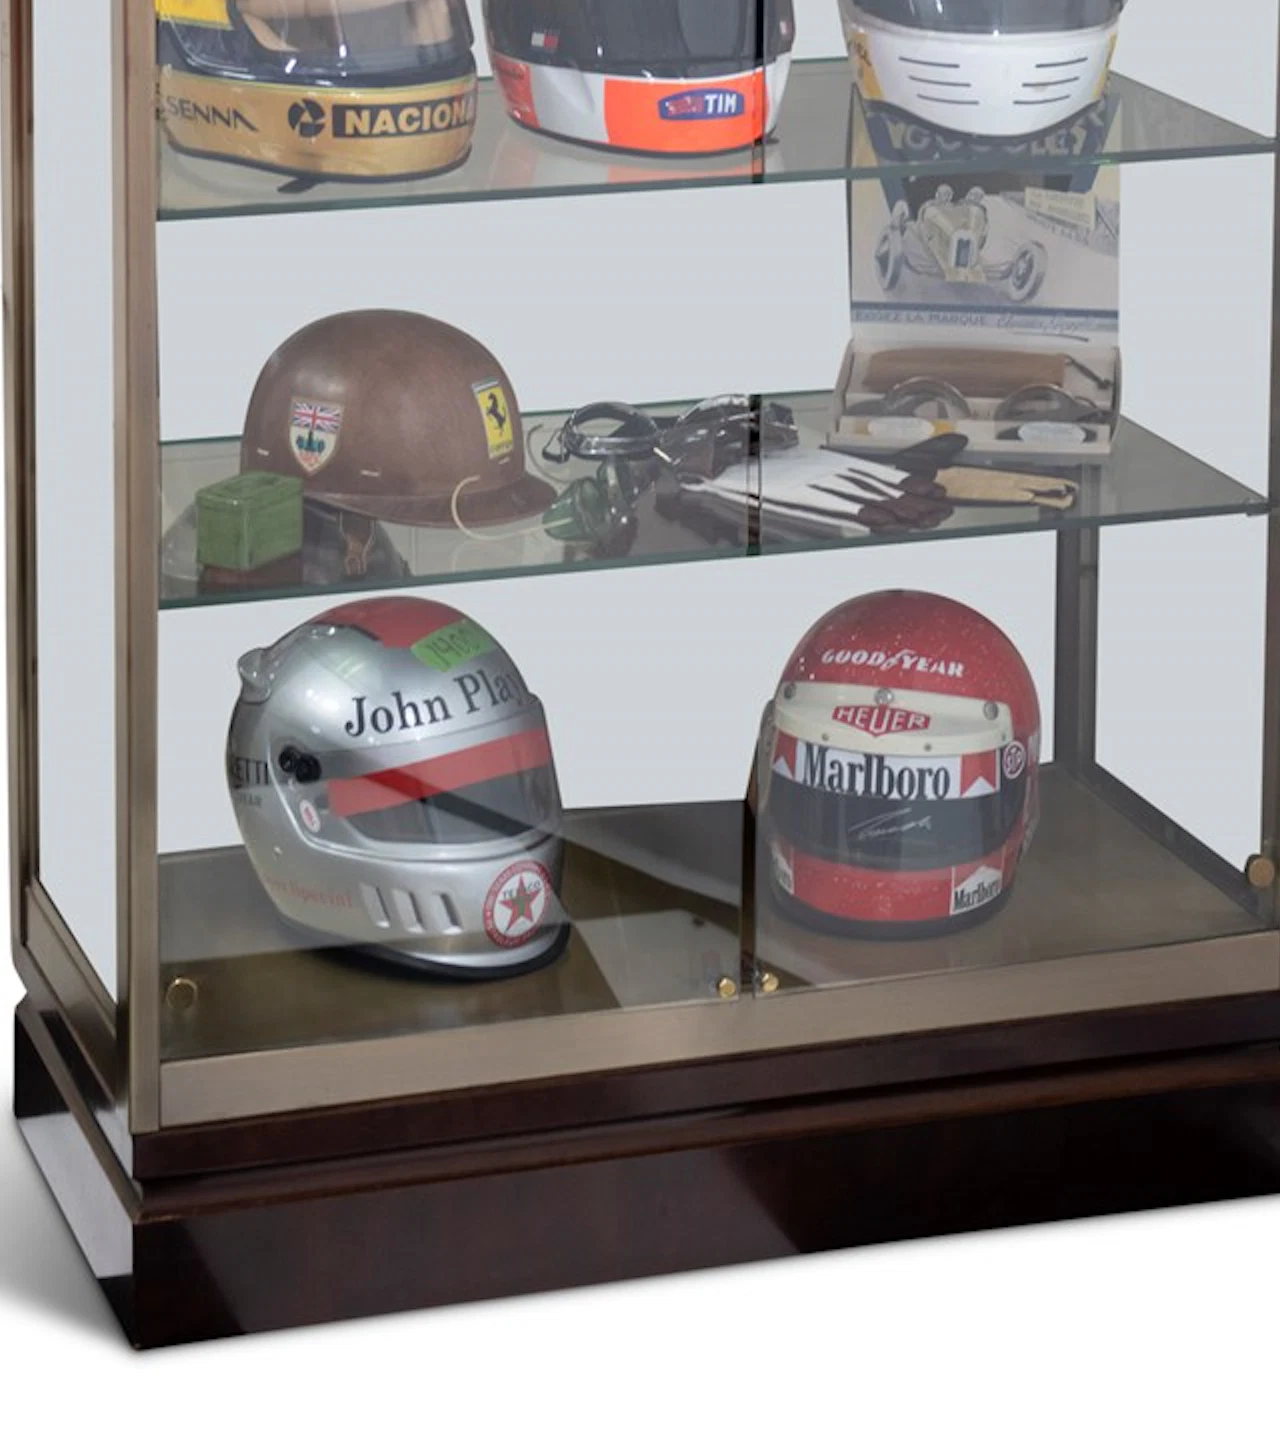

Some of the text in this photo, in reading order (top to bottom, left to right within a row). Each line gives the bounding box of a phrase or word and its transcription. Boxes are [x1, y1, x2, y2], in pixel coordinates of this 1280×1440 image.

[166, 95, 259, 132] SENNA
[704, 93, 738, 114] TIM
[345, 692, 453, 738] John
[835, 707, 928, 735] HEUER
[802, 742, 950, 799] Marlboro
